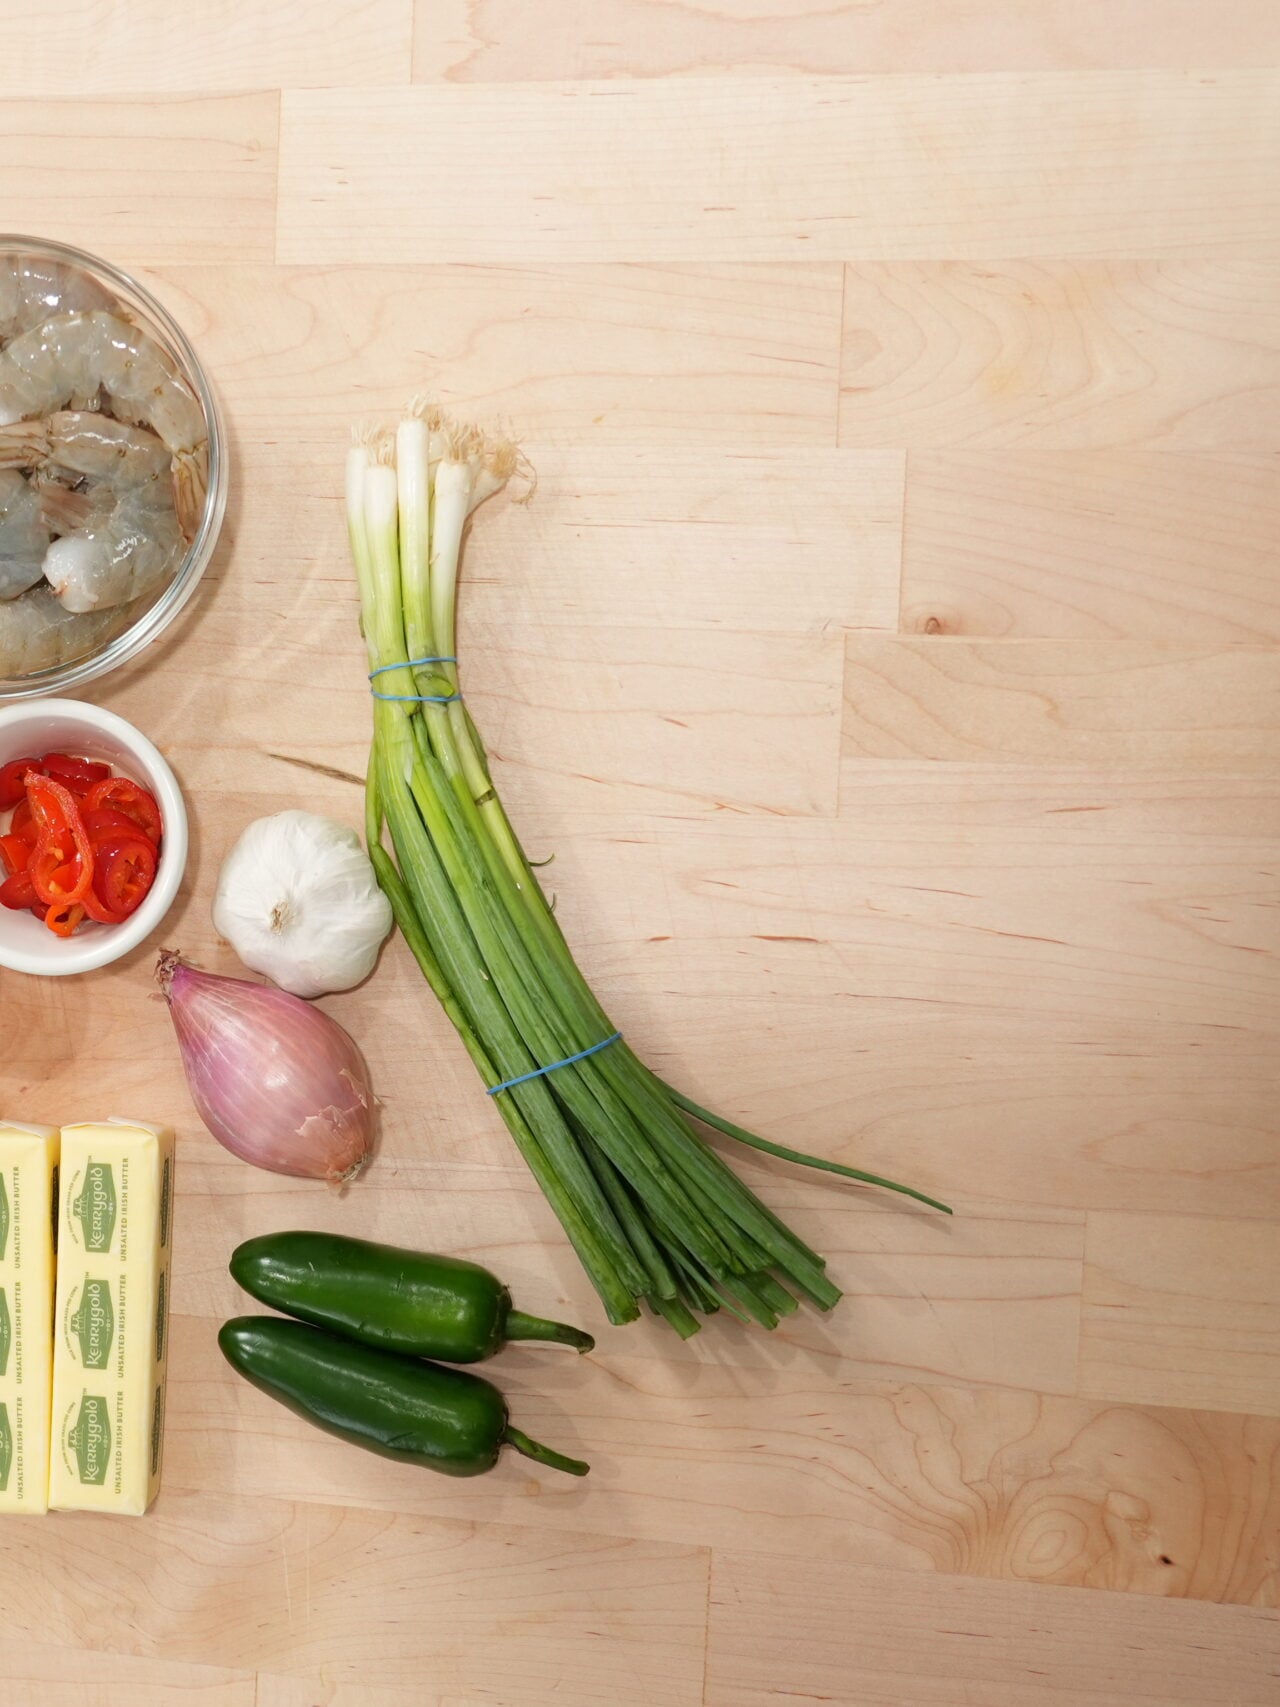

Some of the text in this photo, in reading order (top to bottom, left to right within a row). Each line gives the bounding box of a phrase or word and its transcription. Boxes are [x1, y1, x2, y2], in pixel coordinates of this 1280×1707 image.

[89, 1167, 107, 1248] Kerrygold
[86, 1284, 104, 1365] Kerrygold
[84, 1400, 102, 1481] Kerrygold
